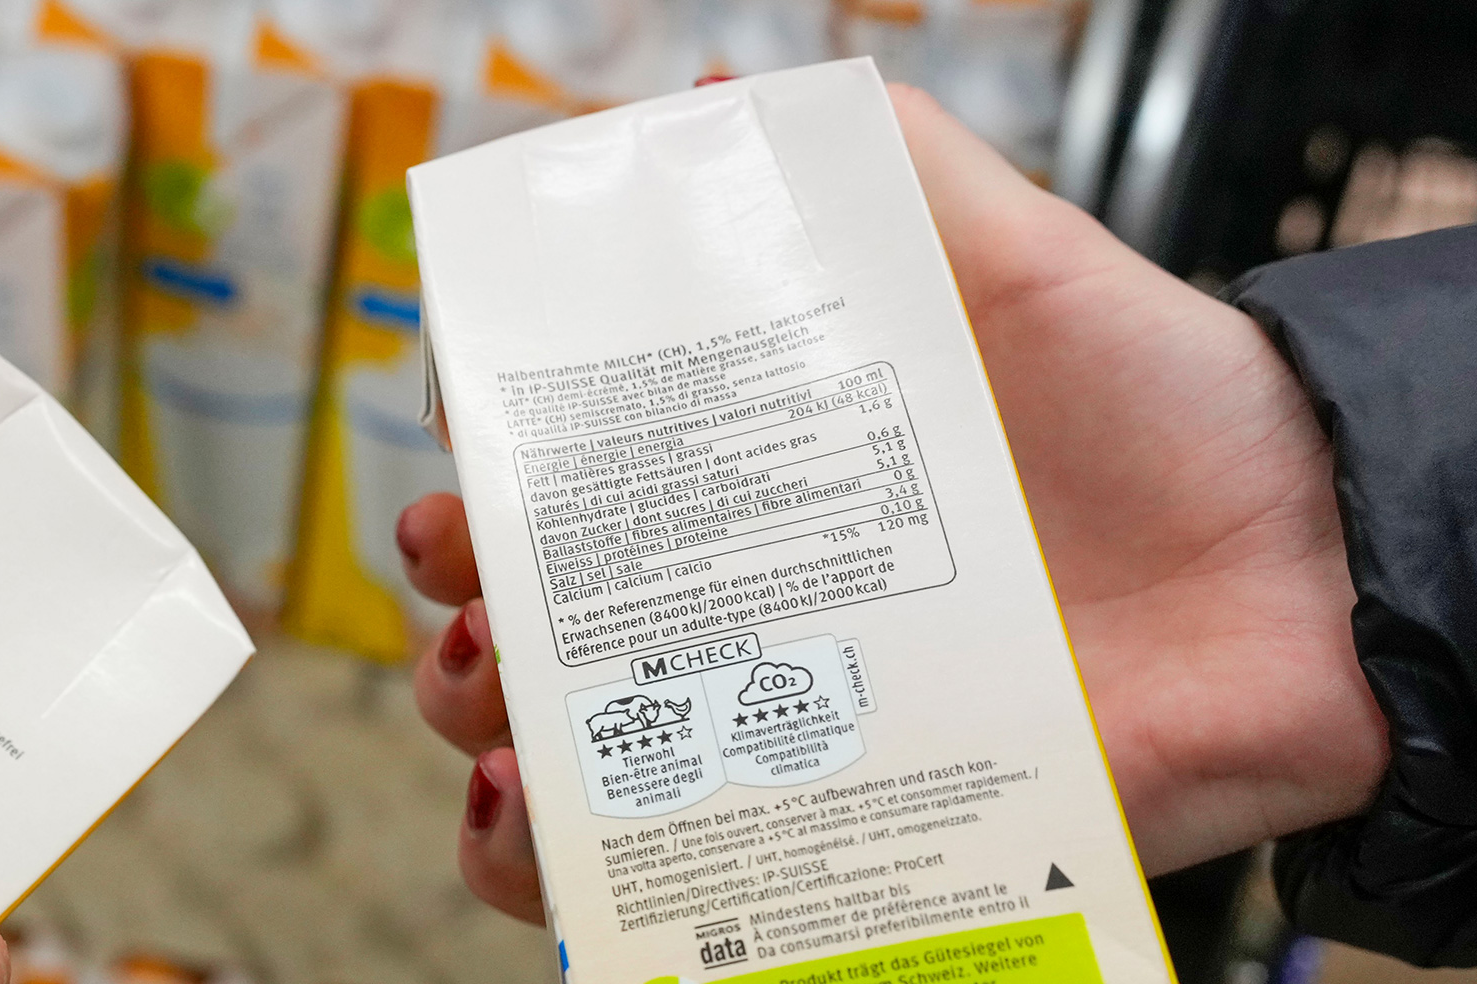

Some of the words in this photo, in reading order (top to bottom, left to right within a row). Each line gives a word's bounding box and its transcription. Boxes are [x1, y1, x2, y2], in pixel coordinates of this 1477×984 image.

[496, 362, 600, 383] Halbentrahmte
[656, 343, 692, 362] (CH),
[695, 333, 732, 351] 1,5%
[734, 324, 767, 341] Fett,
[769, 295, 845, 331] laktosefrei
[552, 584, 604, 605] Calcium
[613, 571, 664, 591] calcium
[673, 559, 712, 578] calcio
[876, 516, 905, 532] 120
[906, 512, 929, 526] mg
[582, 607, 605, 623] der
[606, 585, 706, 617] Referenzmenge
[707, 579, 727, 594] für
[729, 571, 768, 589] einen
[769, 544, 893, 580] durchschnittlichen
[841, 644, 869, 708] m-check.ch
[721, 732, 796, 758] Compatibilité
[796, 721, 855, 742] climatique
[729, 709, 840, 742] Klimaverträglichkeit
[621, 745, 675, 768] Tierwohl
[754, 739, 829, 765] Compatibilità
[769, 757, 820, 776] climatica
[600, 765, 658, 788] Bien-être
[659, 753, 703, 774] animal
[605, 776, 670, 800] Benessere
[671, 766, 703, 785] degli
[600, 832, 635, 851] Nach
[636, 826, 666, 843] dem
[667, 816, 712, 836] Öffnen
[713, 808, 736, 826] bei
[737, 804, 770, 820] max.
[809, 777, 896, 805] aufbewahren
[898, 769, 926, 787] und
[927, 762, 965, 781] rasch
[966, 758, 997, 773] kon-
[634, 785, 681, 808] animali
[845, 959, 886, 980] trägt
[889, 954, 920, 971] das
[922, 936, 1012, 965] Gütesiegel
[1013, 933, 1045, 948] von
[972, 953, 1037, 975] Weitere
